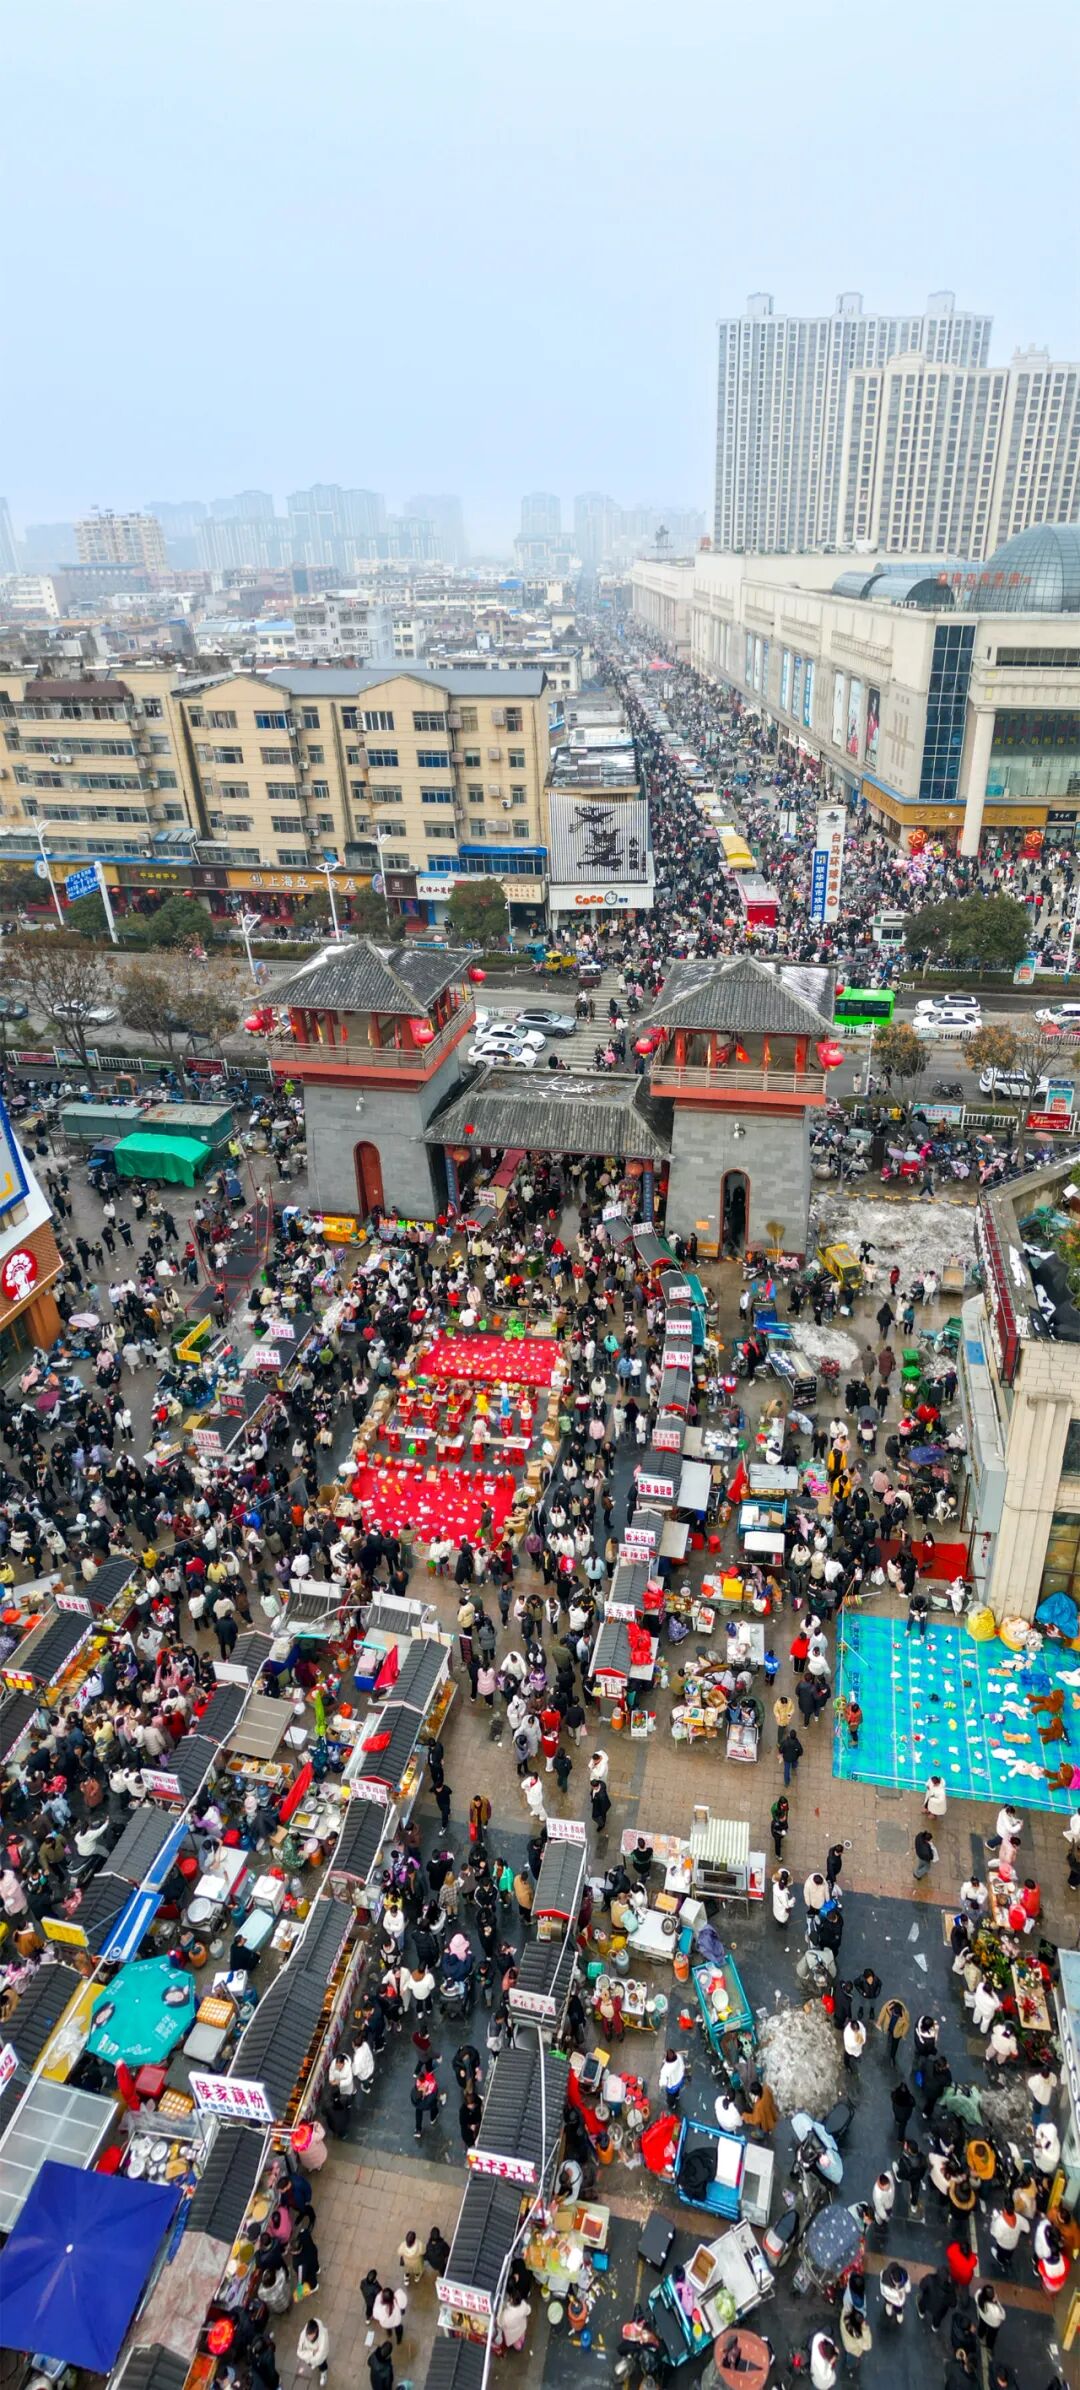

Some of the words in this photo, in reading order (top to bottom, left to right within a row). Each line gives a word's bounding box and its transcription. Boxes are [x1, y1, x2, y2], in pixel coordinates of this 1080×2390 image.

[827, 833, 841, 892] 白马环球港
